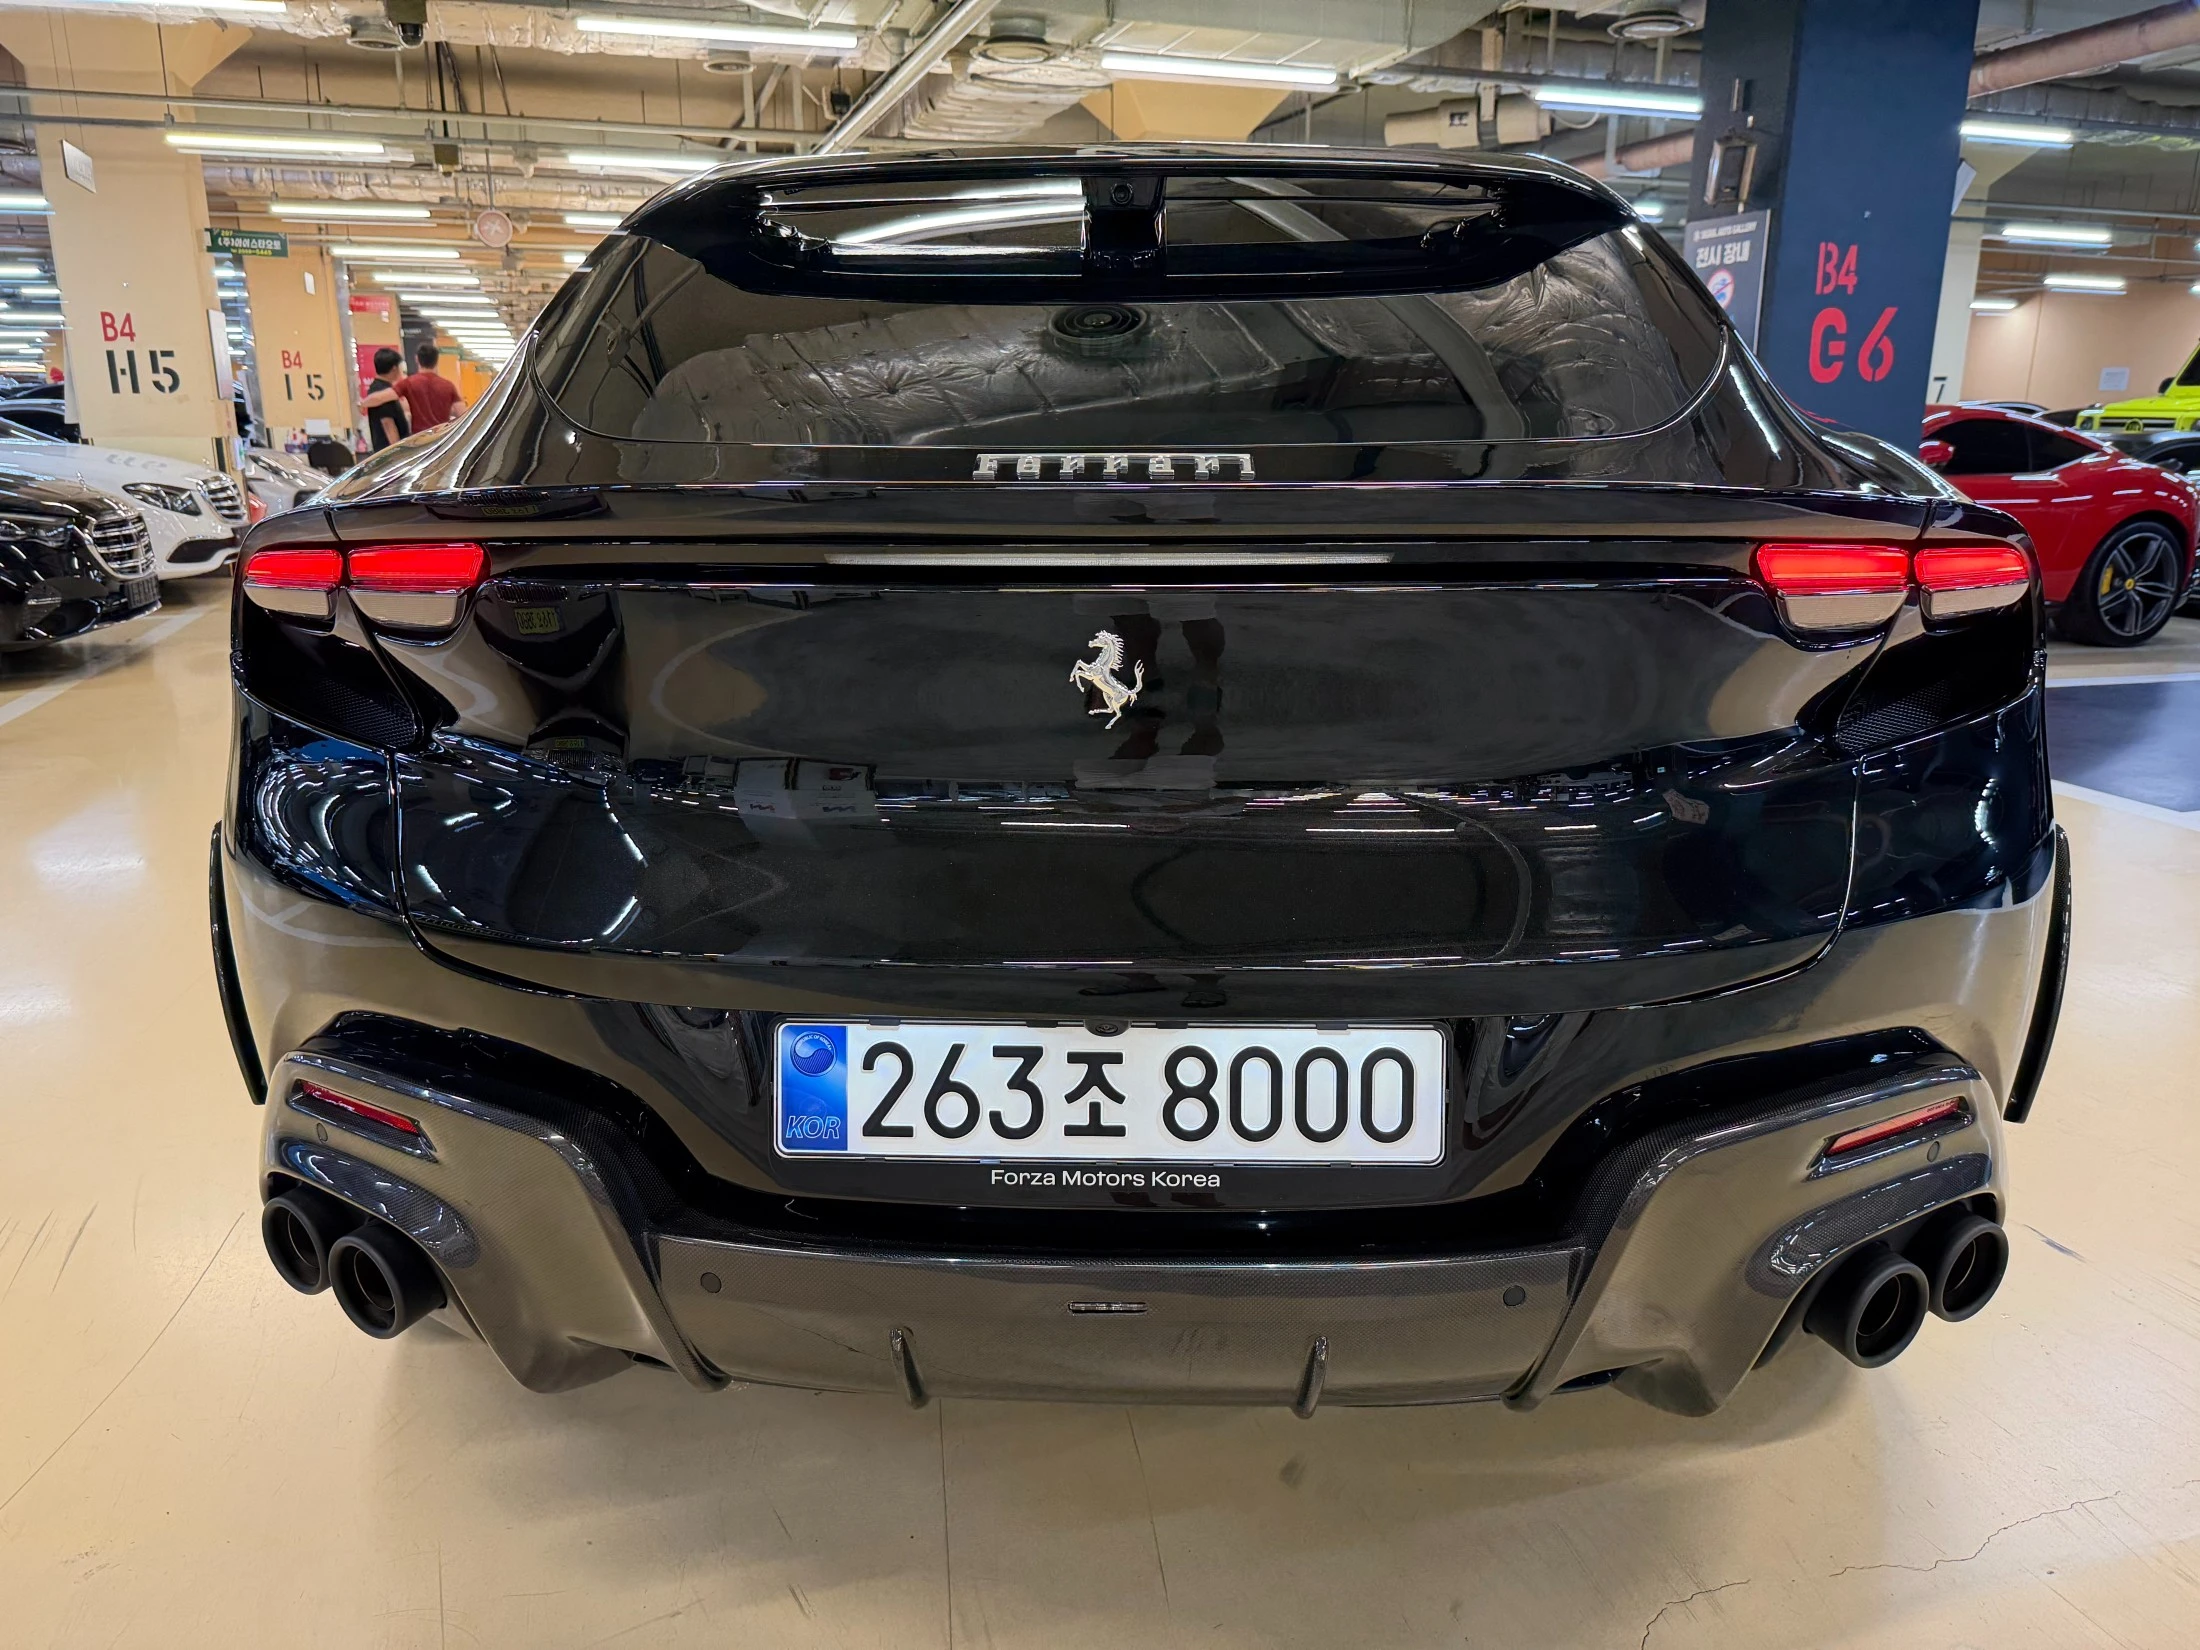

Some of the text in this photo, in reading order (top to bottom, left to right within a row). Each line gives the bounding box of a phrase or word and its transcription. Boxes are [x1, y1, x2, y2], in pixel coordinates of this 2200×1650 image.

[1695, 243, 1722, 269] 전시
[1815, 241, 1859, 295] B4
[100, 310, 136, 342] B4
[281, 350, 303, 369] B4
[860, 1041, 1416, 1143] 263조 8000
[785, 1115, 841, 1139] KOR
[991, 1169, 1221, 1188] Forza Motors Korea
